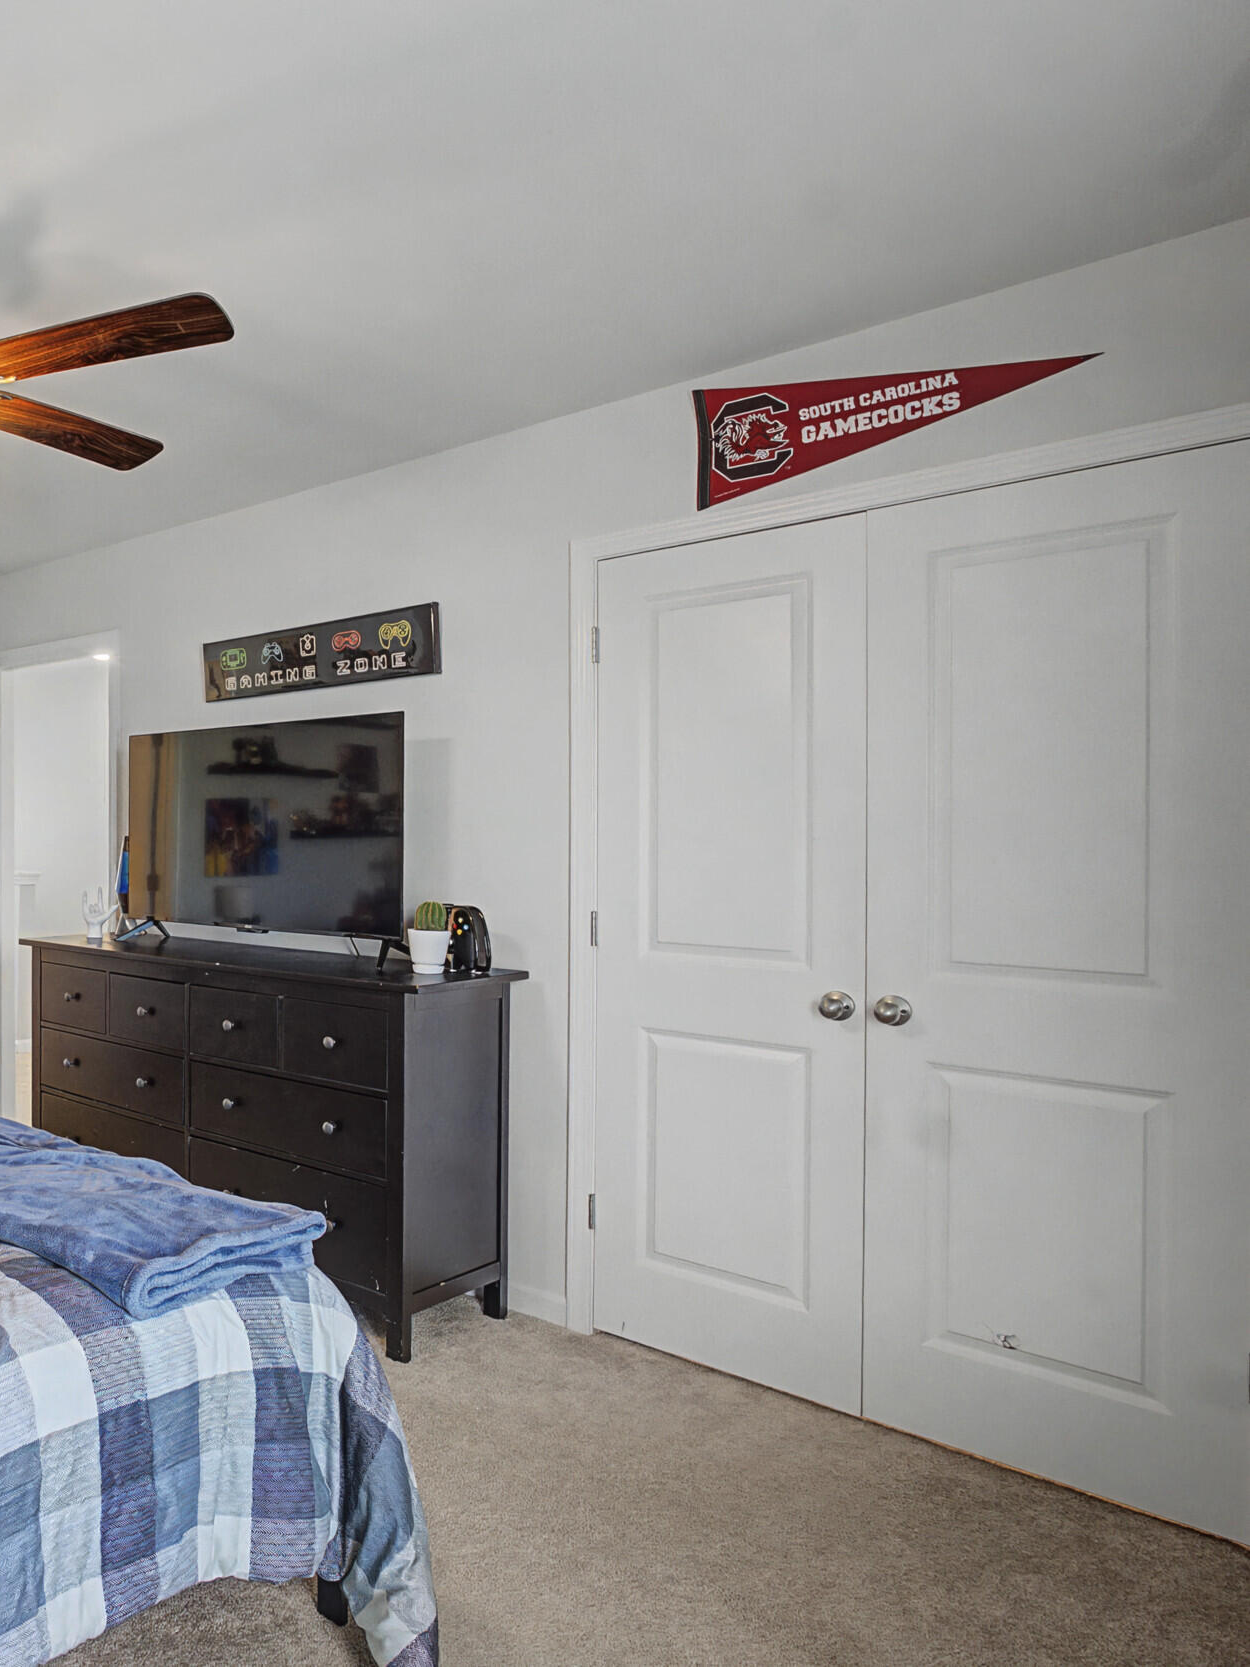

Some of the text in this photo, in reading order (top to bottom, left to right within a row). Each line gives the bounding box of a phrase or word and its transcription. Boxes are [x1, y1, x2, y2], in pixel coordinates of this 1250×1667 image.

[798, 371, 959, 421] SOUTH CAROLINA
[802, 391, 961, 444] GAMECOCKS
[225, 651, 407, 691] GAMING ZONE
